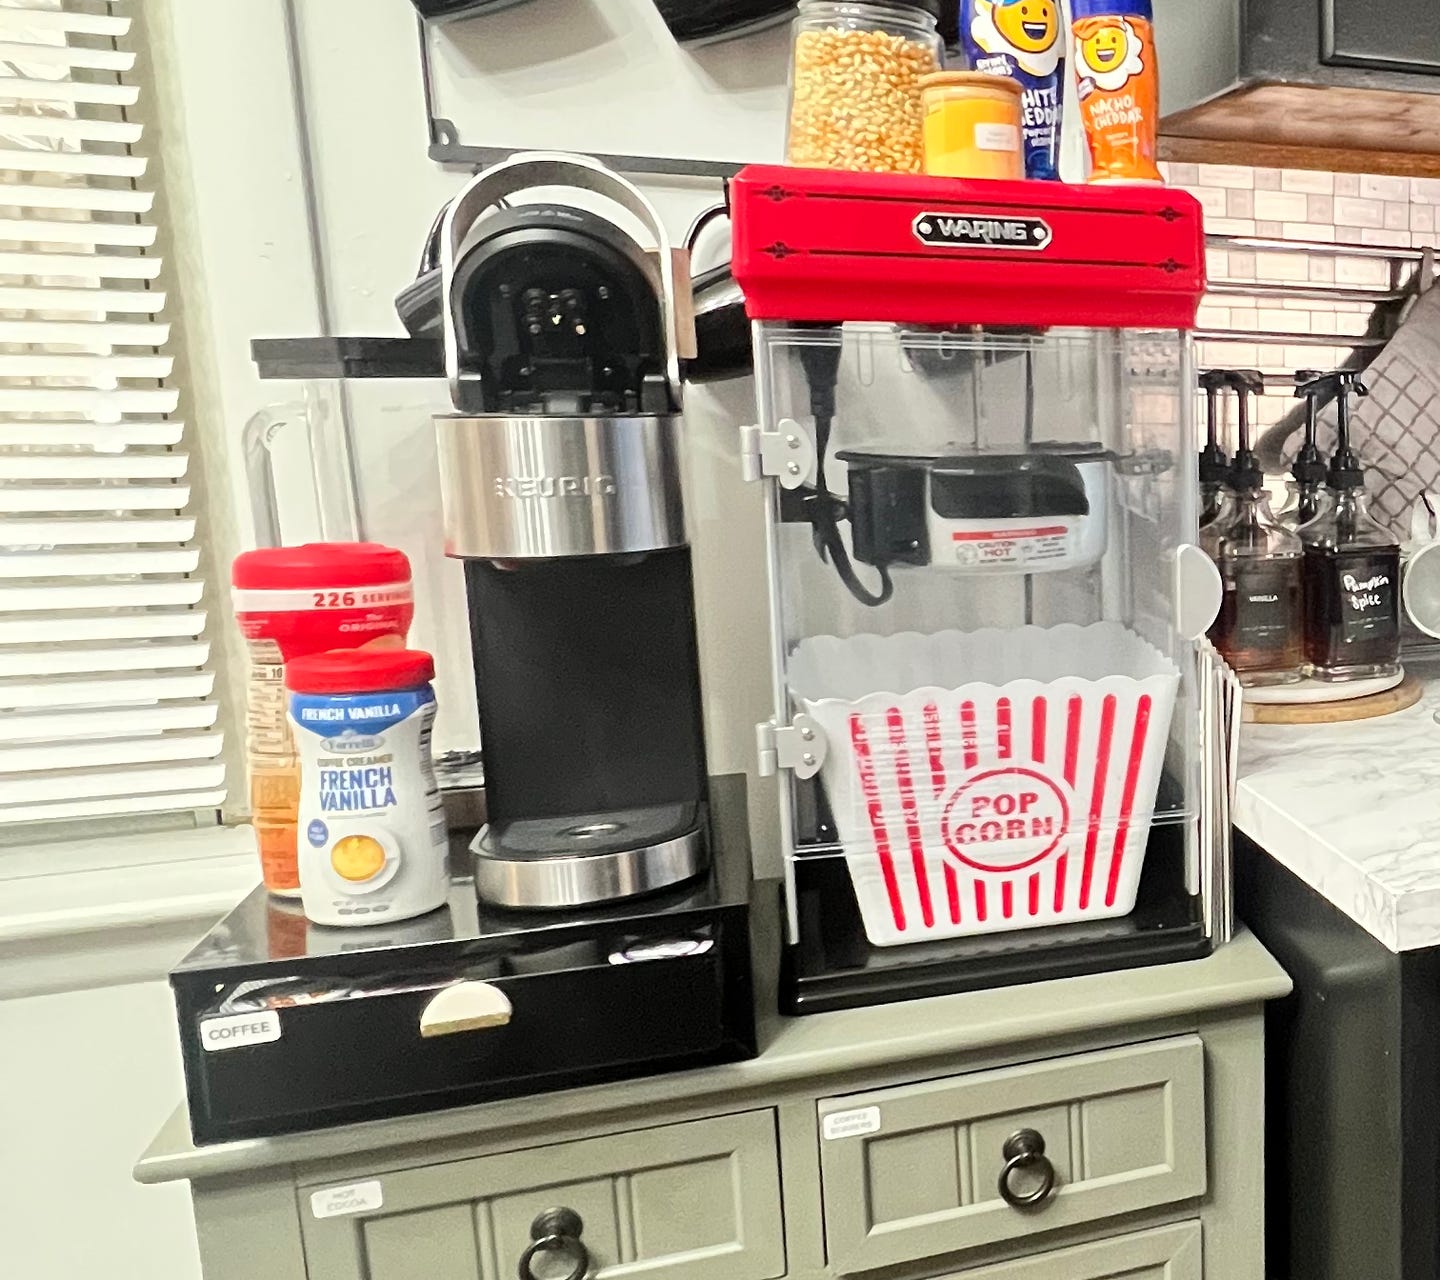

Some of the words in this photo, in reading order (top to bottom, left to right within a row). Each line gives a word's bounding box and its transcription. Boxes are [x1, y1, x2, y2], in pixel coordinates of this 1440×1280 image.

[1089, 94, 1133, 117] NACHO
[1094, 106, 1144, 130] CHEDDAR
[937, 217, 1029, 243] WARING
[495, 475, 617, 497] KEURIG
[984, 547, 1012, 557] HOT
[312, 592, 355, 608] 226
[1350, 593, 1382, 611] Spice
[301, 707, 345, 721] FRENCH
[347, 703, 401, 720] VANILLA
[320, 766, 393, 790] FRENCH
[318, 787, 398, 812] VANILLA
[971, 792, 1040, 818] POP
[955, 816, 1054, 845] CORN
[208, 1021, 272, 1042] COFFEE
